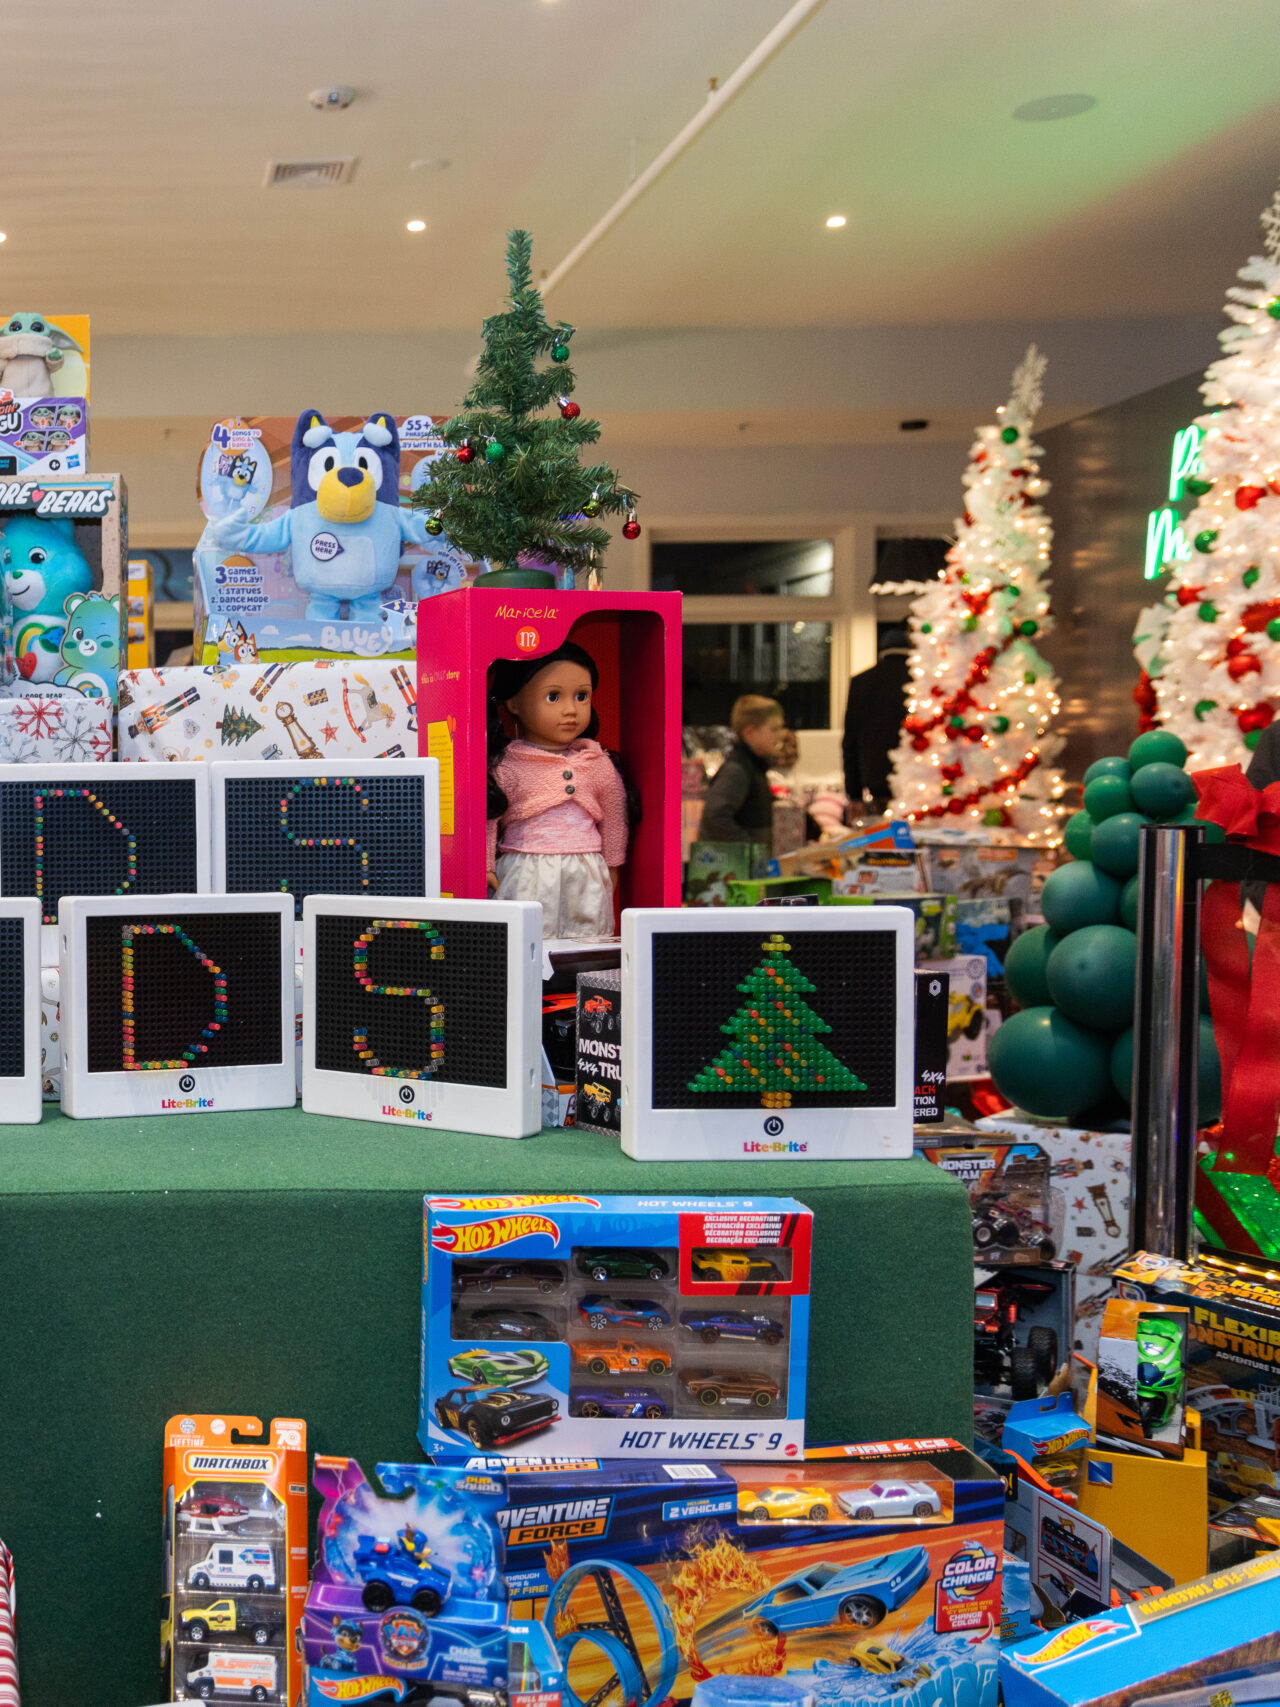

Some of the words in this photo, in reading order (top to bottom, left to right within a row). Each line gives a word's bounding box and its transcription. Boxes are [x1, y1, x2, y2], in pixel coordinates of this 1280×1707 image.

[406, 420, 431, 431] 55+
[213, 425, 230, 448] 4
[38, 490, 113, 513] BEARS
[215, 566, 227, 584] 3
[228, 576, 239, 584] TO
[225, 587, 262, 595] STATUES
[226, 604, 262, 612] COPYCAT
[495, 605, 557, 620] Maricela
[280, 777, 369, 912] S
[35, 788, 137, 923] D
[122, 924, 227, 1071] D
[353, 920, 445, 1080] S
[937, 1160, 996, 1171] MONSTER
[956, 1170, 980, 1179] JAM
[672, 1200, 735, 1208] WHEELS
[1215, 1351, 1270, 1372] ADVENTURE
[432, 1443, 445, 1454] 3+
[619, 1432, 665, 1449] HOT
[766, 1432, 783, 1449] 9
[844, 1443, 891, 1456] FIRE
[896, 1441, 913, 1452] &
[916, 1439, 949, 1450] ICE
[193, 1457, 269, 1470] MATCHBOX
[669, 1508, 680, 1518] 2
[681, 1501, 732, 1517] VEHICLES
[517, 1521, 597, 1542] FORCE
[944, 1556, 997, 1576] COLOR
[942, 1570, 995, 1588] CHANGE
[1139, 1583, 1213, 1615] TAKEDOWN
[448, 1646, 482, 1658] CHASE
